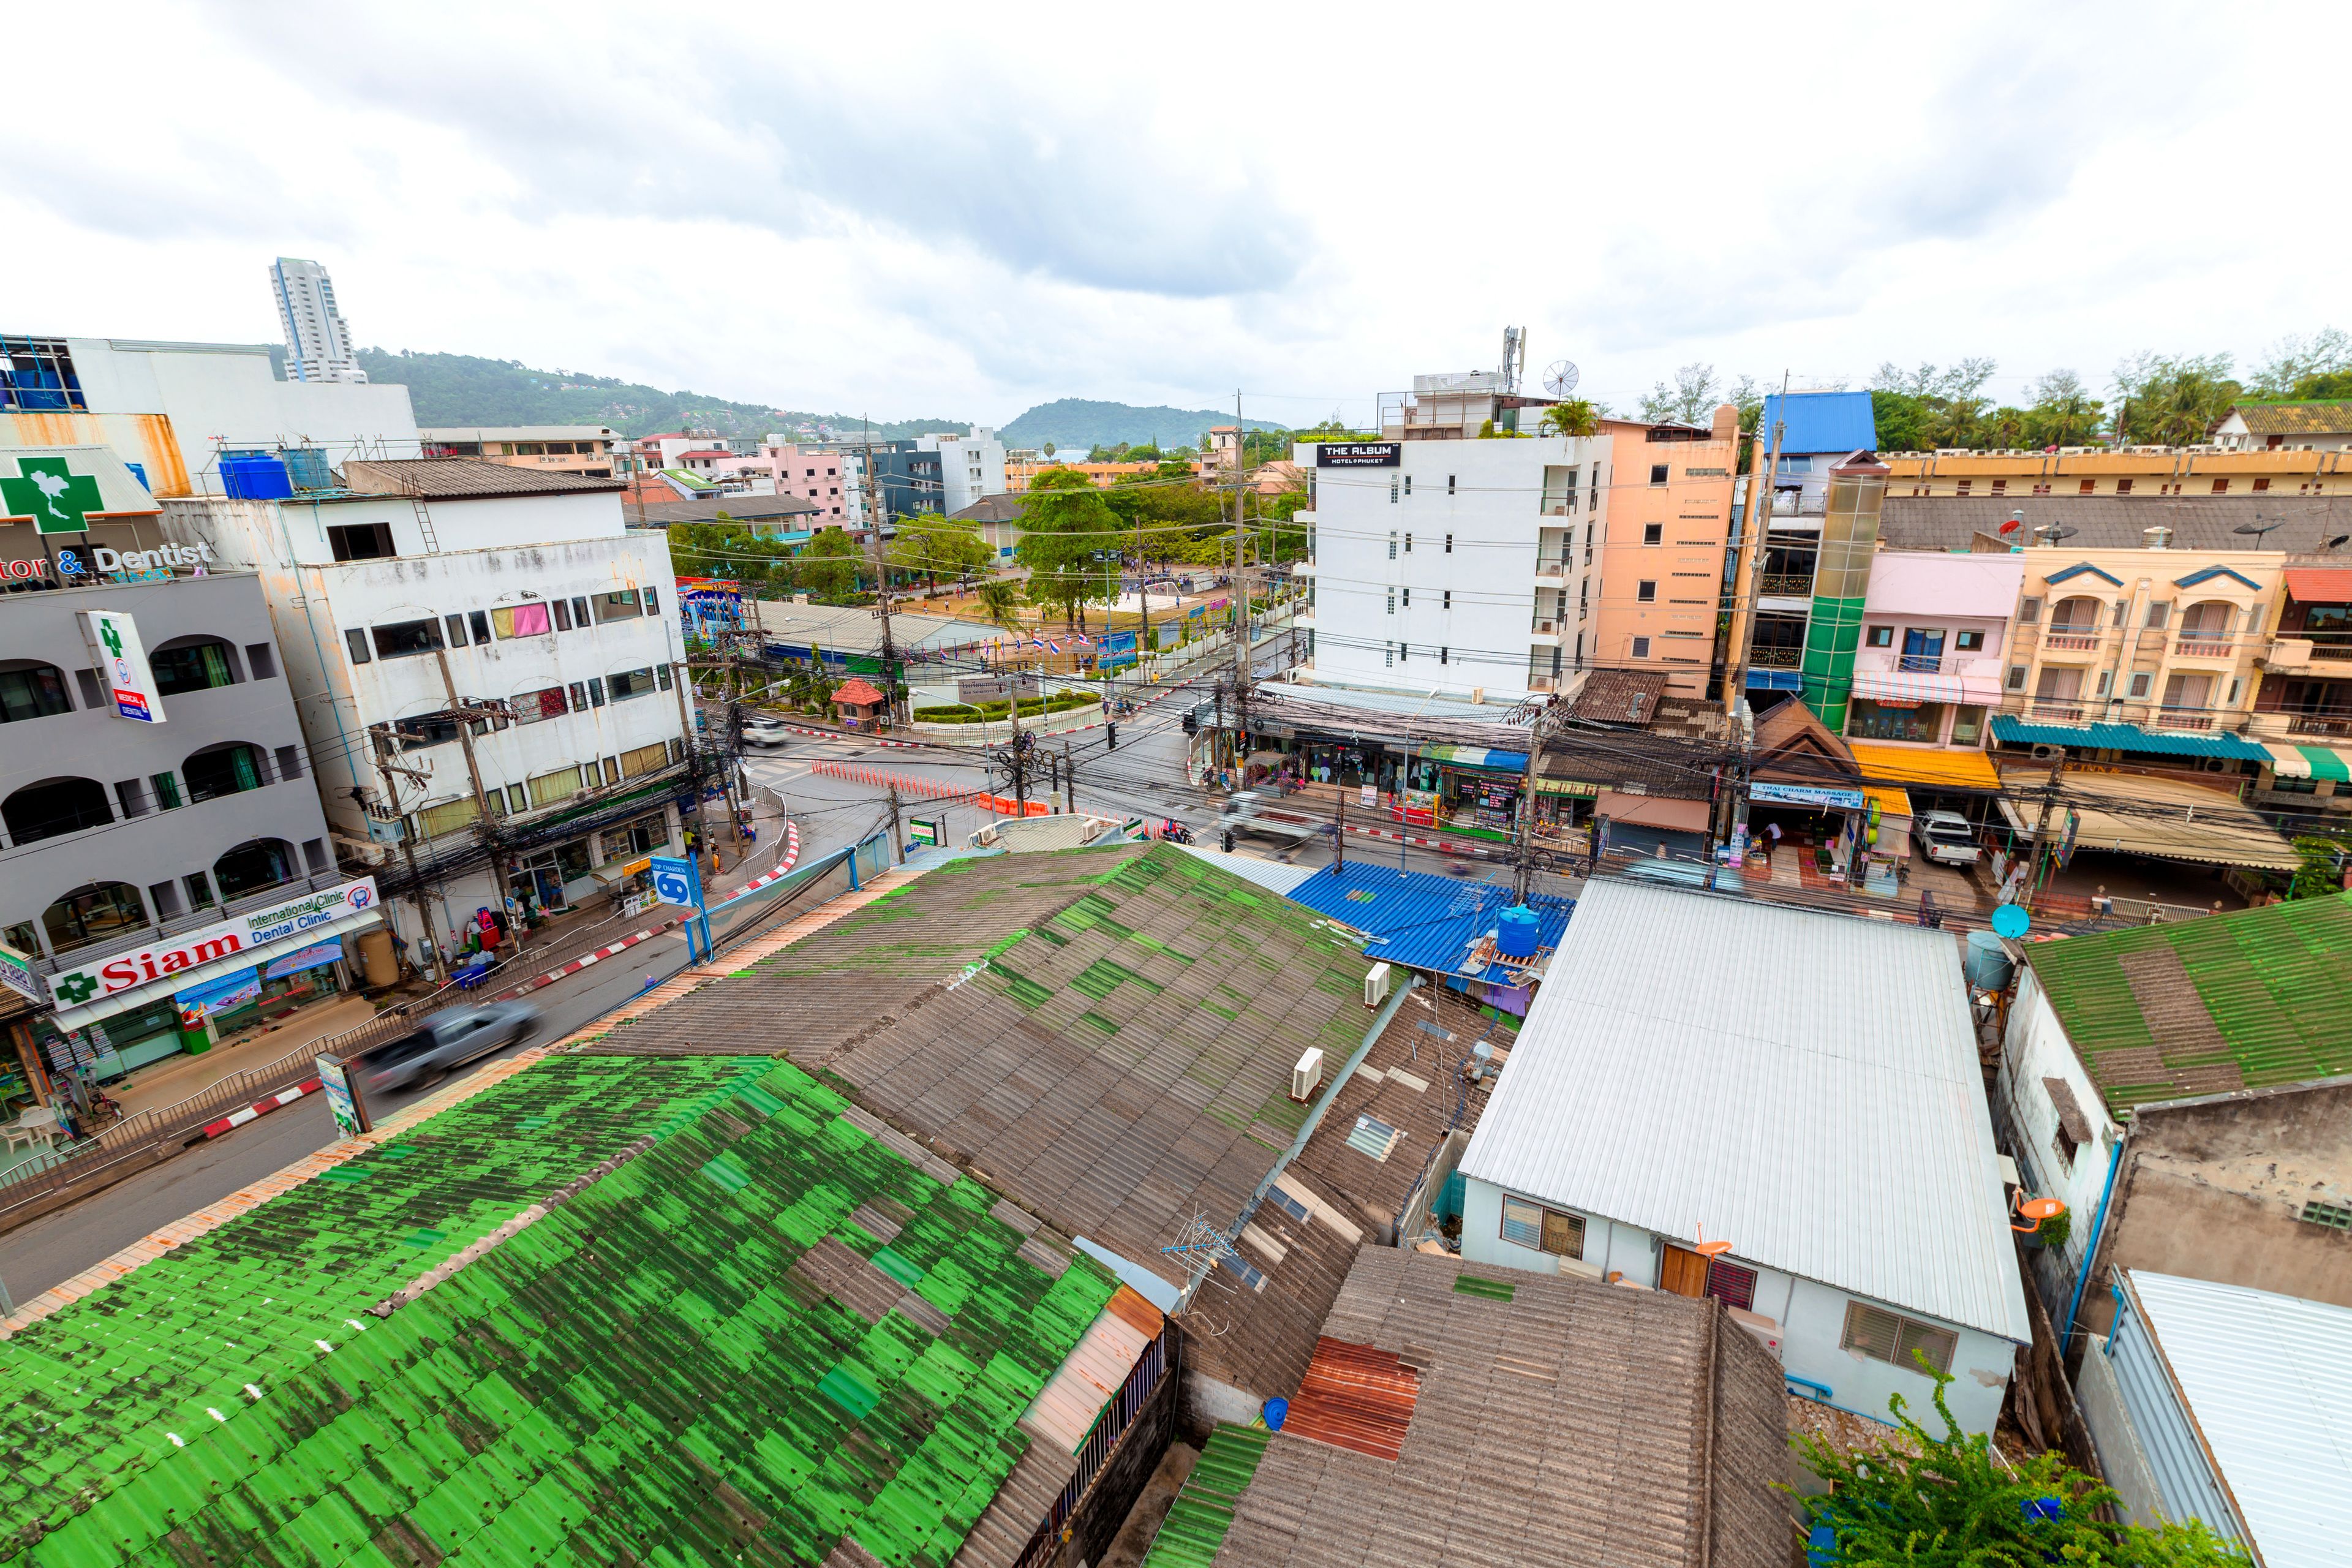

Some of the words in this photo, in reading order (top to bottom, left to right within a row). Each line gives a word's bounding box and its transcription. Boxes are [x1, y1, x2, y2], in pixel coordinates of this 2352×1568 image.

[58, 550, 86, 575] &
[92, 541, 213, 572] Dentist
[117, 693, 140, 704] MEDICAL
[122, 706, 144, 717] DENTAL
[911, 826, 933, 835] EXCHANGE
[247, 899, 316, 929] International
[315, 891, 345, 907] Clinic
[252, 921, 295, 944] Dental
[298, 910, 331, 929] Clinic
[102, 934, 244, 993] Siam
